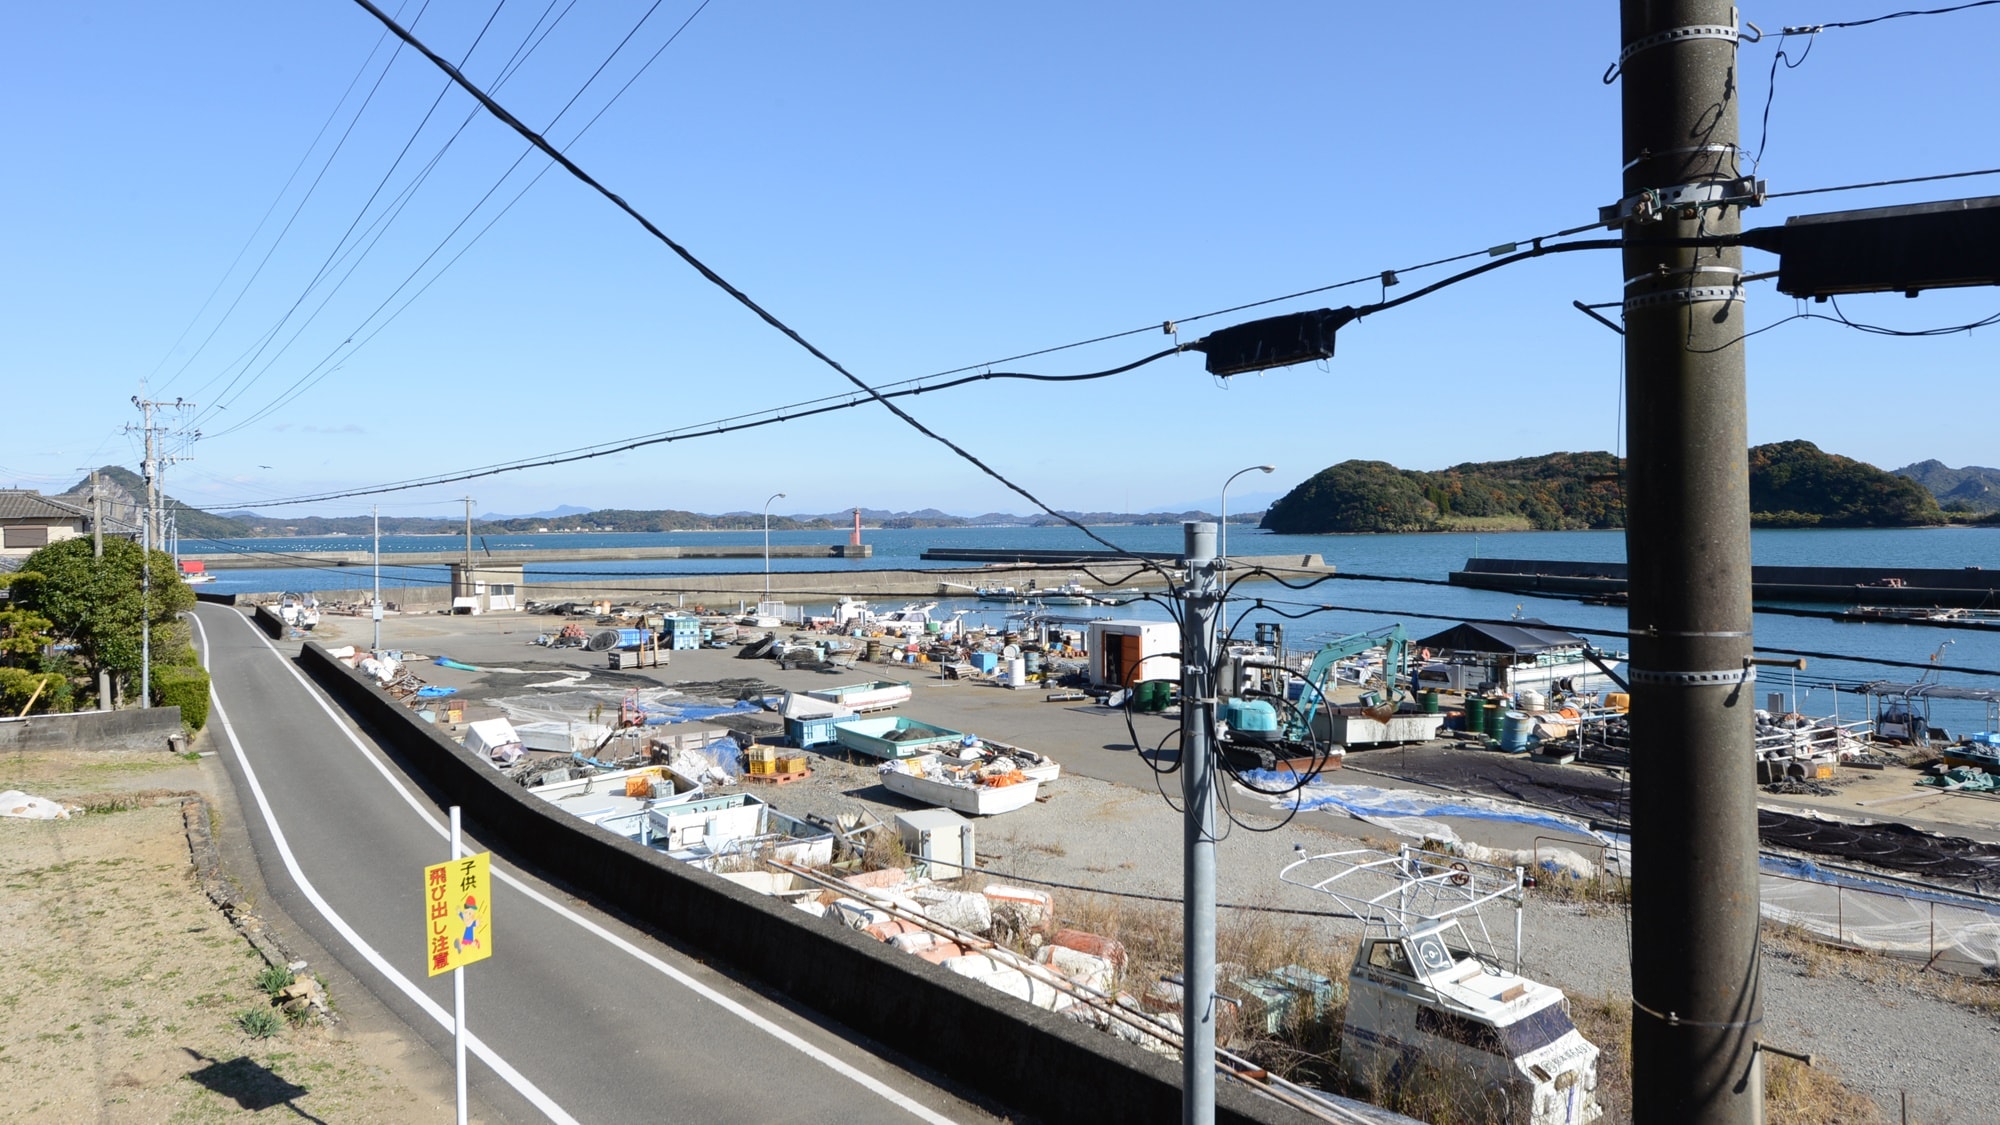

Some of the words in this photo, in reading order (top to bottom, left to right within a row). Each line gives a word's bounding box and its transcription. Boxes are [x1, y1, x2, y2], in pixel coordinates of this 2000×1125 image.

[460, 860, 477, 892] 子供
[429, 866, 449, 971] 飛び出し注意
